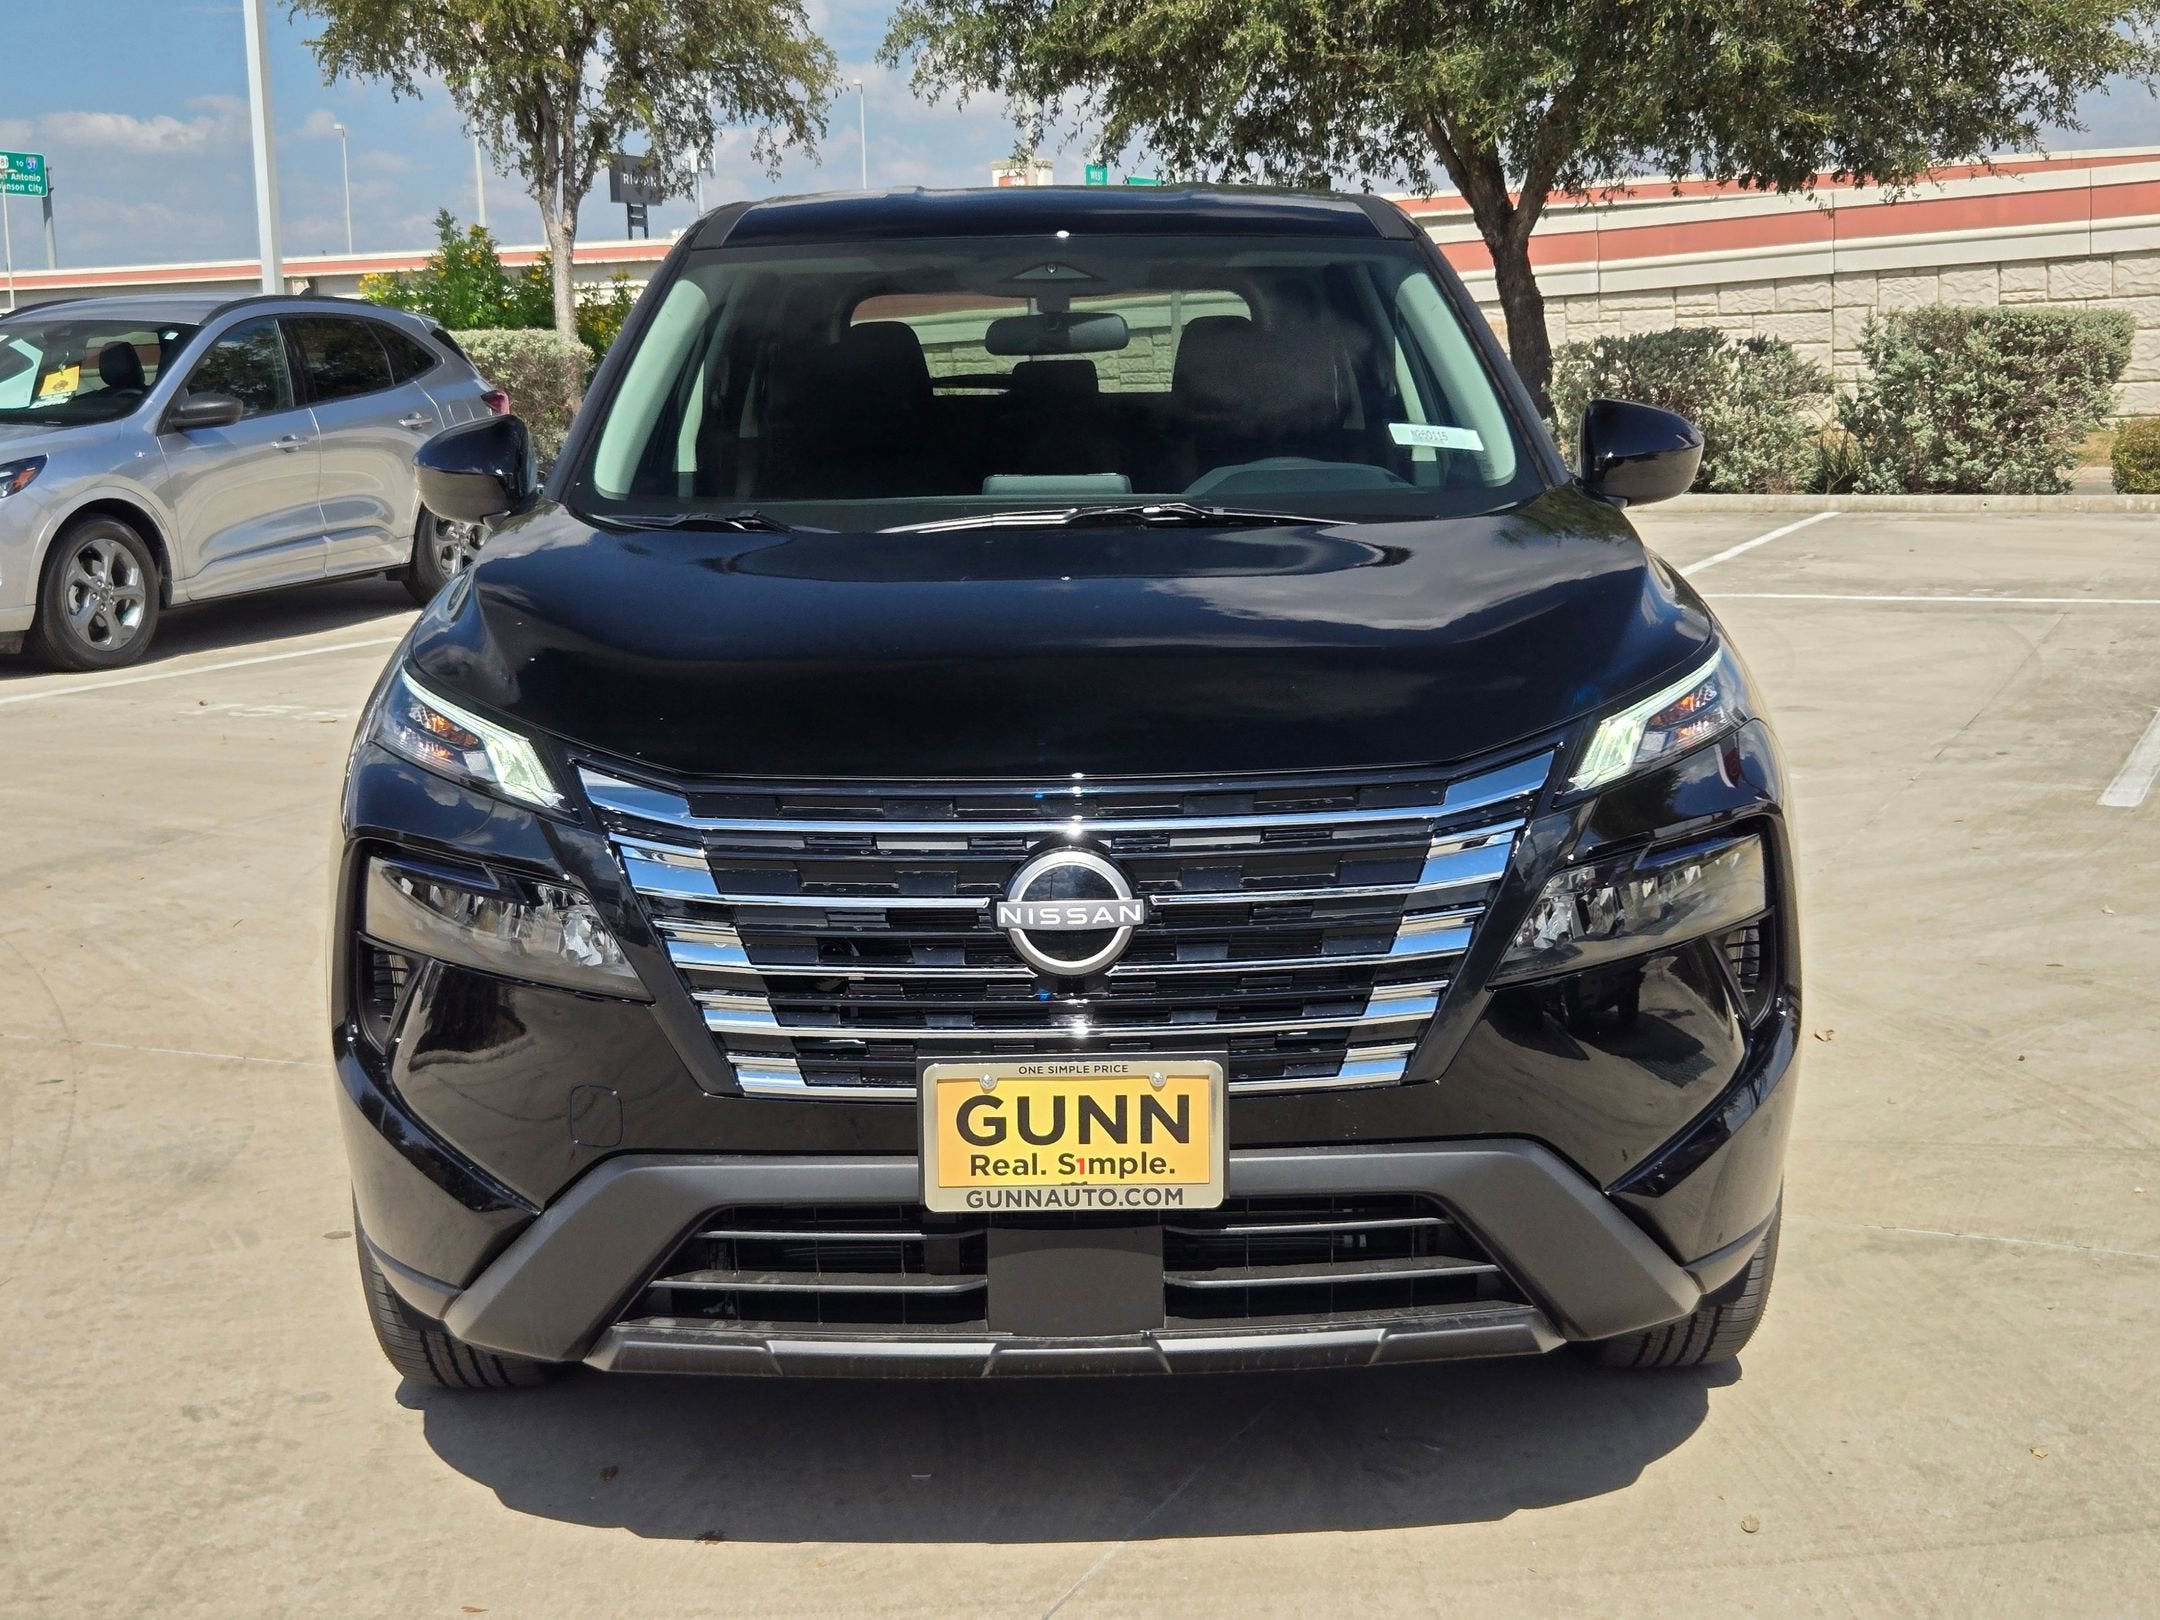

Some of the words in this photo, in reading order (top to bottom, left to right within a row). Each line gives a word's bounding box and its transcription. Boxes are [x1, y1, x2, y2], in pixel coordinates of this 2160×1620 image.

[26, 160, 36, 170] 37
[11, 172, 41, 182] Antonio
[28, 183, 43, 194] City
[1000, 904, 1141, 925] NISSAN
[1018, 1066, 1044, 1075] ONE
[1048, 1065, 1090, 1075] SIMPLE
[1094, 1064, 1129, 1073] PRICE
[956, 1094, 1190, 1147] GUNN
[970, 1153, 1047, 1177] Real.
[966, 1188, 1183, 1209] GUNNAUTO.COM
